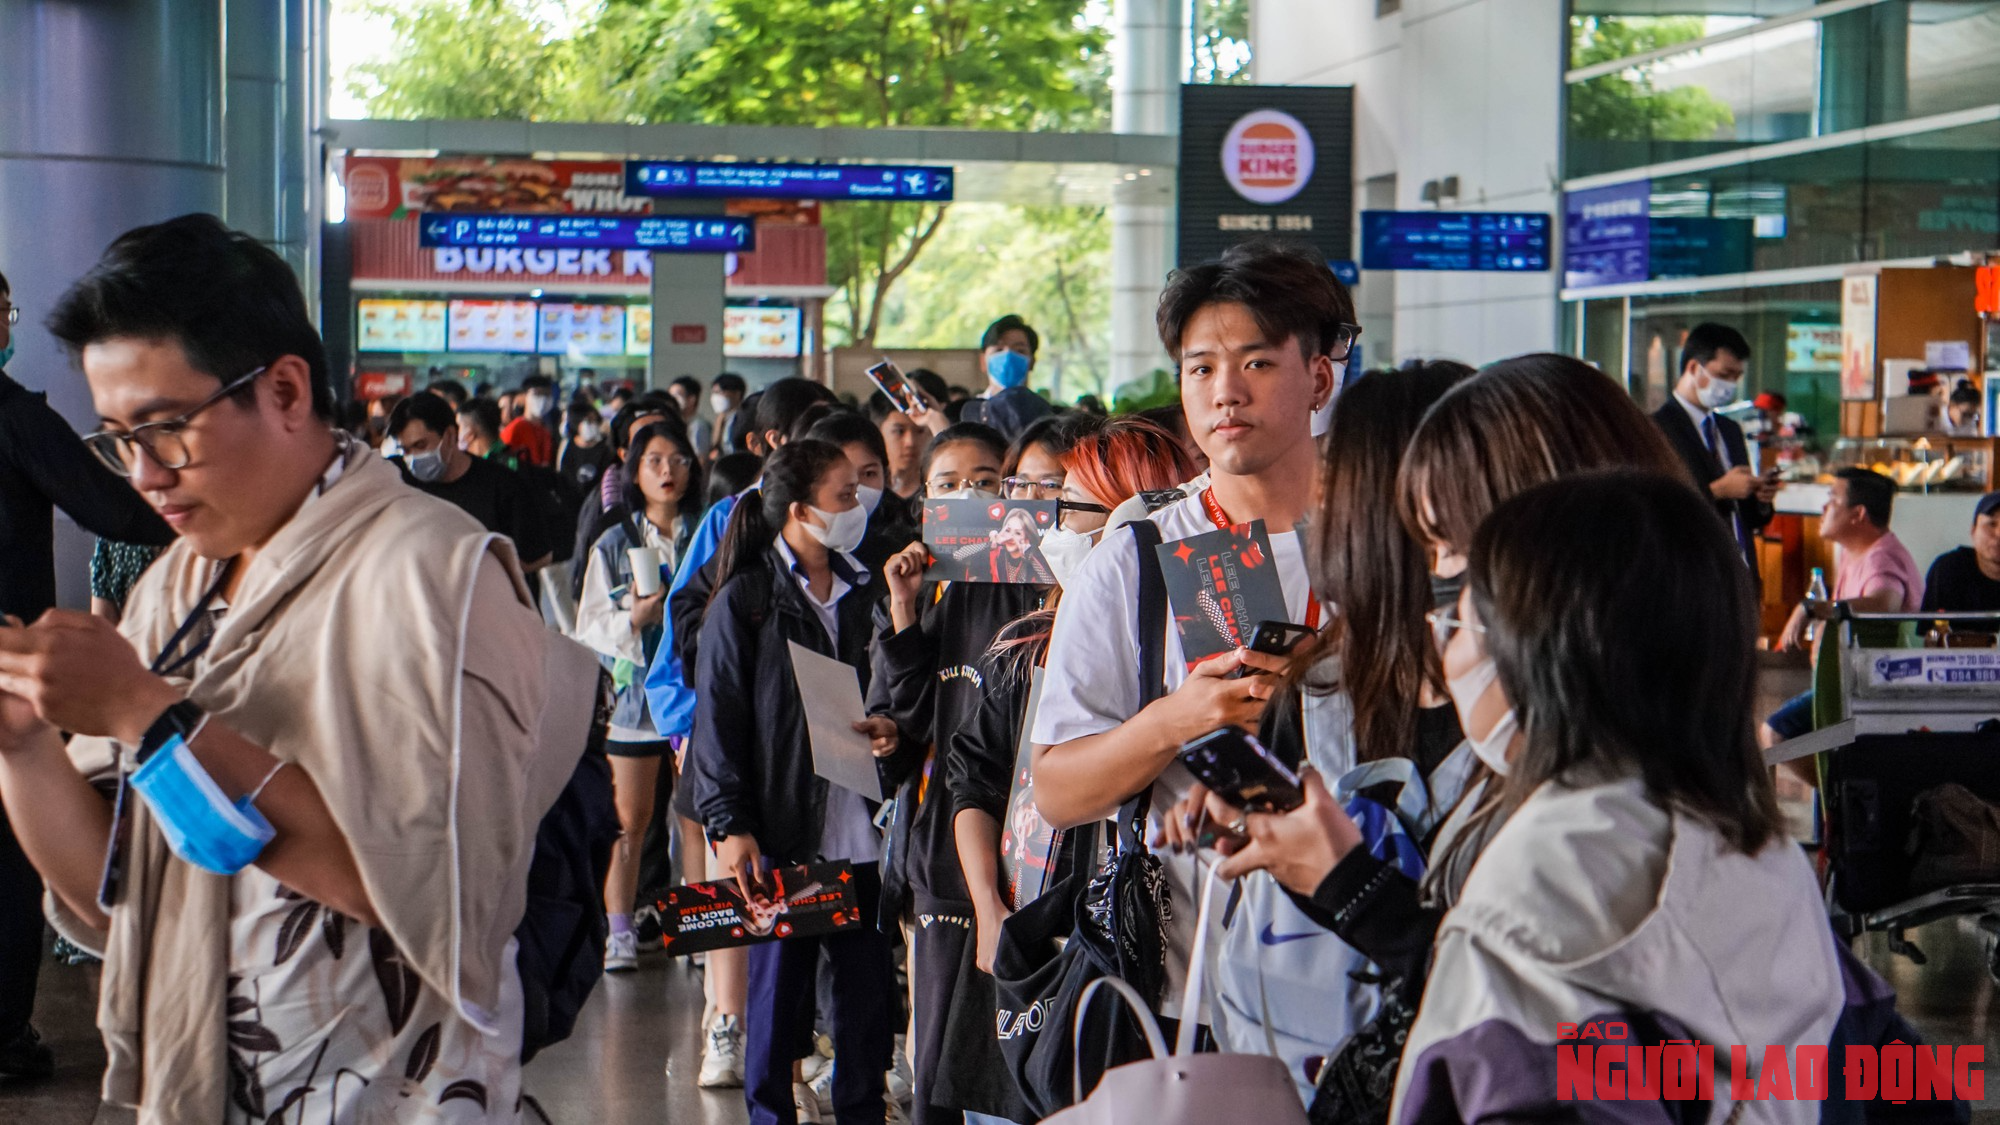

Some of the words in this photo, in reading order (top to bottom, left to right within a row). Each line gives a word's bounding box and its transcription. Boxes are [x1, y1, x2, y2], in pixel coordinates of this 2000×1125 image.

[1239, 143, 1296, 154] BURGER
[1239, 159, 1297, 175] KING
[1218, 214, 1271, 231] SINCE
[434, 247, 612, 275] BURGER
[935, 537, 957, 545] LEE
[1196, 557, 1215, 596] LEE
[1208, 555, 1227, 593] LEE
[1221, 552, 1240, 591] LEE
[820, 892, 842, 903] LEE
[679, 901, 734, 915] VIETNAM
[701, 908, 735, 920] BACK
[678, 916, 742, 932] WELCOME
[682, 914, 699, 923] TO
